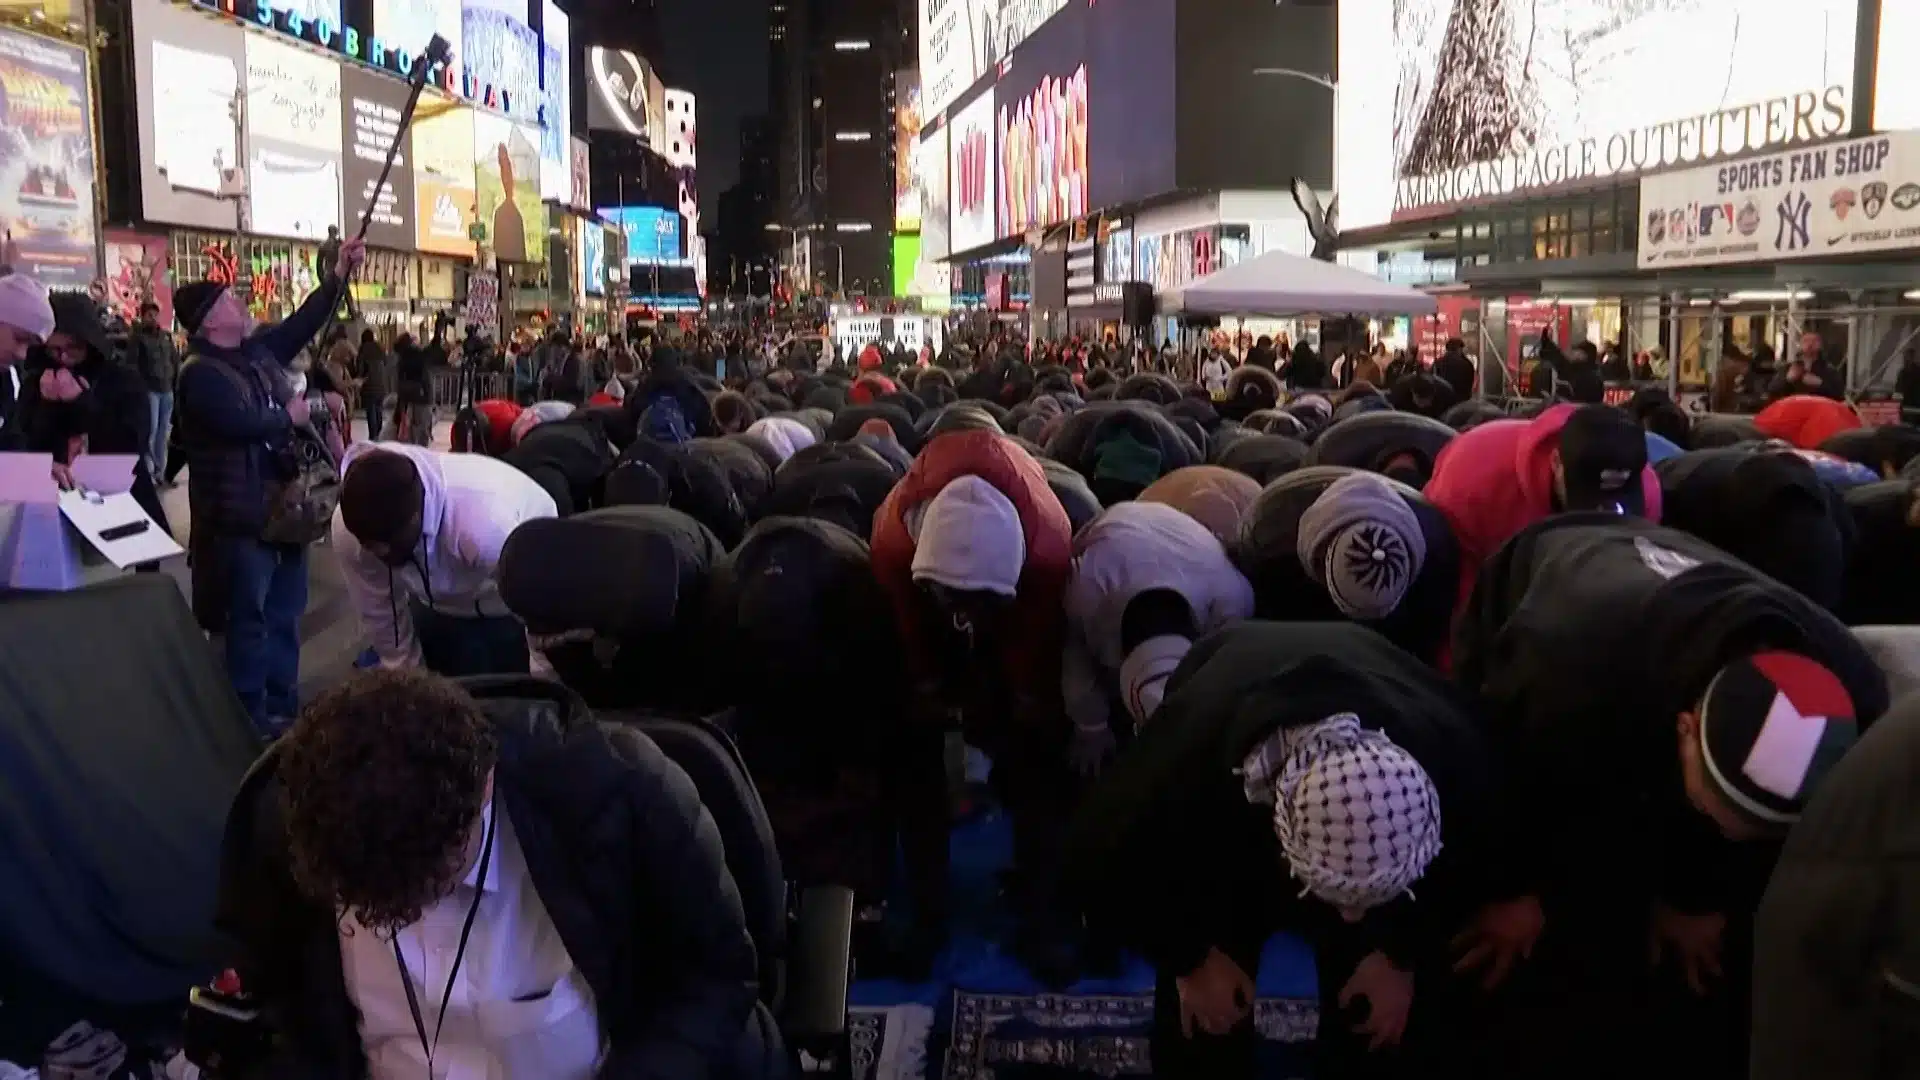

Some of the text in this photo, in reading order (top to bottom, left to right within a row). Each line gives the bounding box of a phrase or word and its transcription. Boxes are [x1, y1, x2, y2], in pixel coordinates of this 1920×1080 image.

[1394, 85, 1846, 212] AMERICAN EAGLE OUTFITTERS
[1718, 138, 1890, 195] SPORTS FAN SHOP
